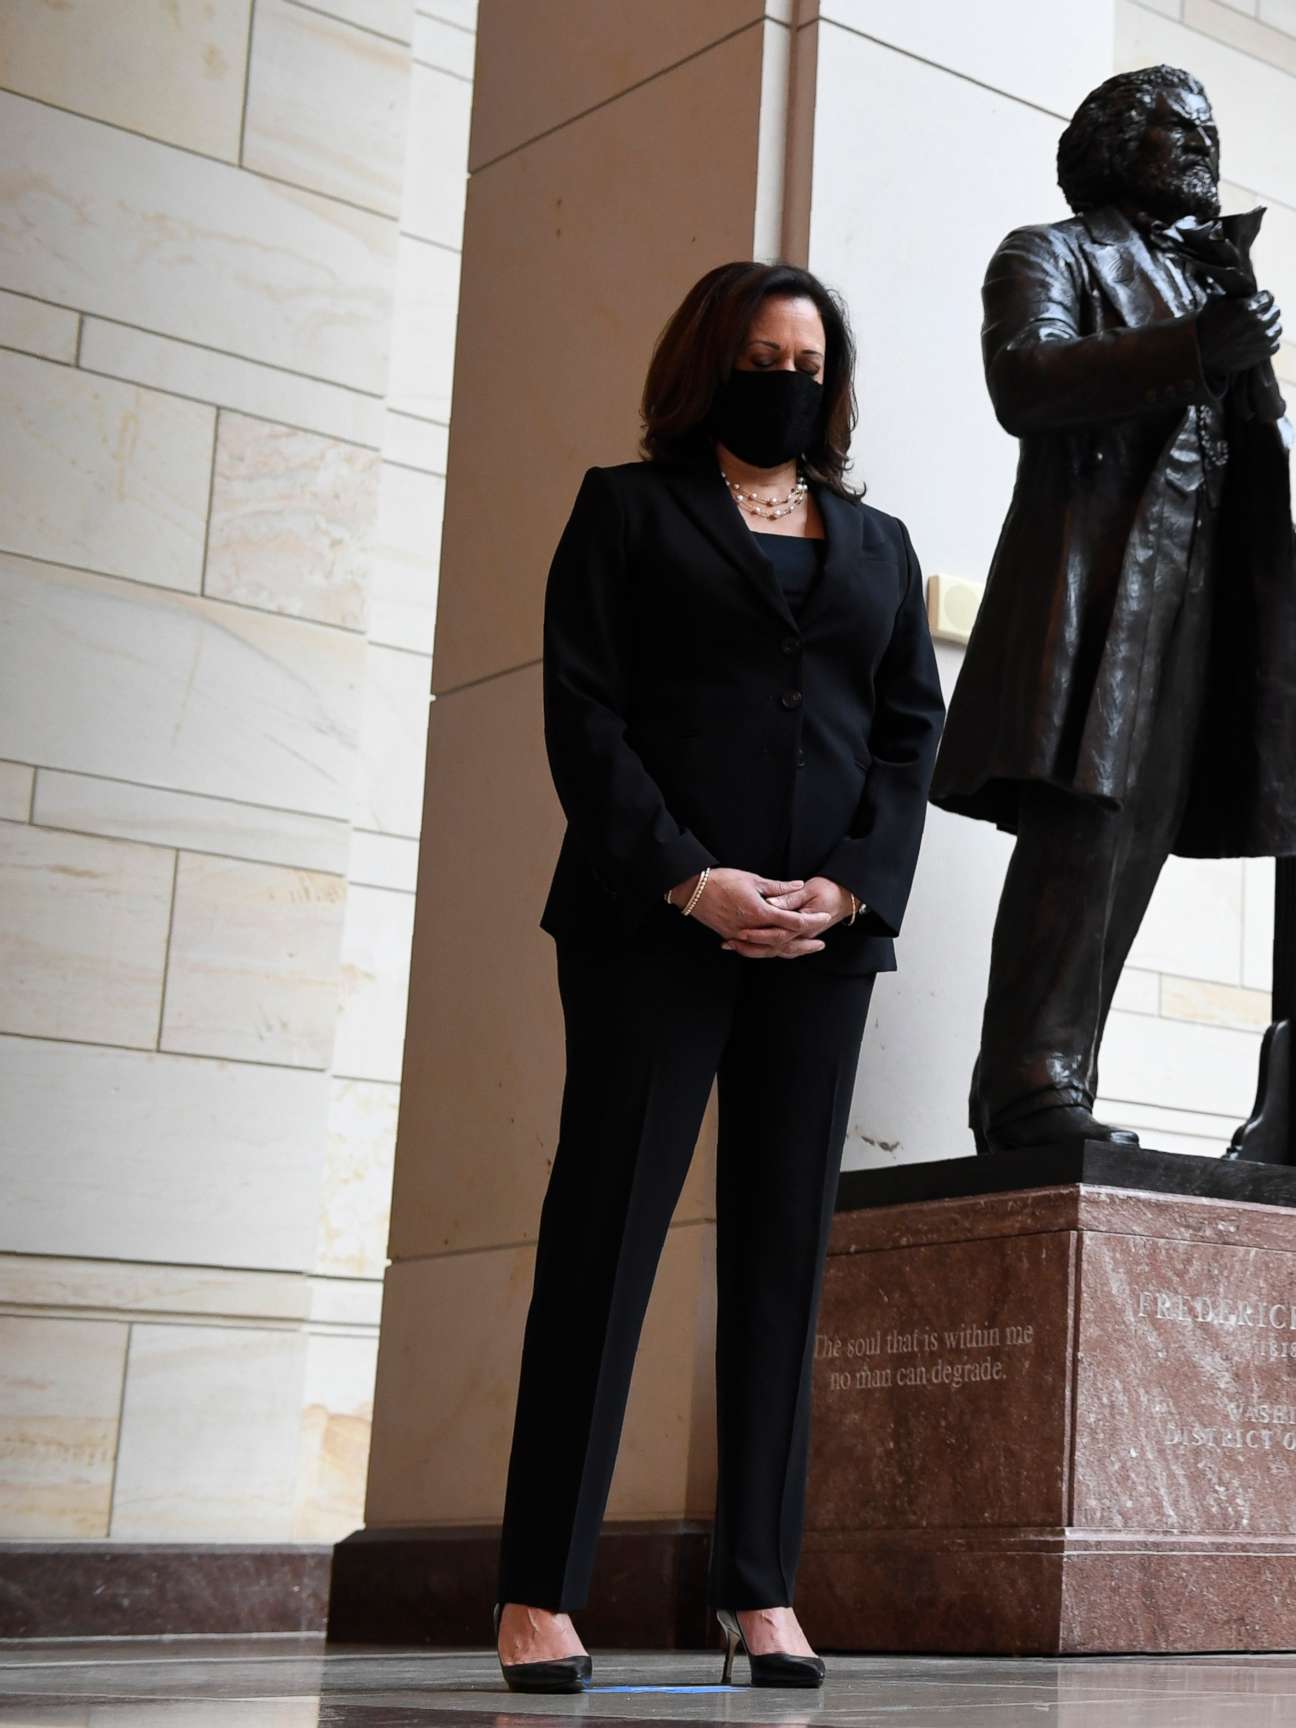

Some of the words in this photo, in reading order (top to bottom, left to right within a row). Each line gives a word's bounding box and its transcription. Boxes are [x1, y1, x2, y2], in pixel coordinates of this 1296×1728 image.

[848, 1331, 881, 1358] soul
[887, 1329, 919, 1354] that
[924, 1326, 939, 1351] is
[944, 1322, 1001, 1349] within
[1005, 1324, 1034, 1346] me
[830, 1371, 851, 1391] no
[856, 1369, 892, 1389] man
[897, 1366, 927, 1386] can
[932, 1356, 1007, 1388] degrade.
[1165, 1425, 1273, 1450] DISTRICT
